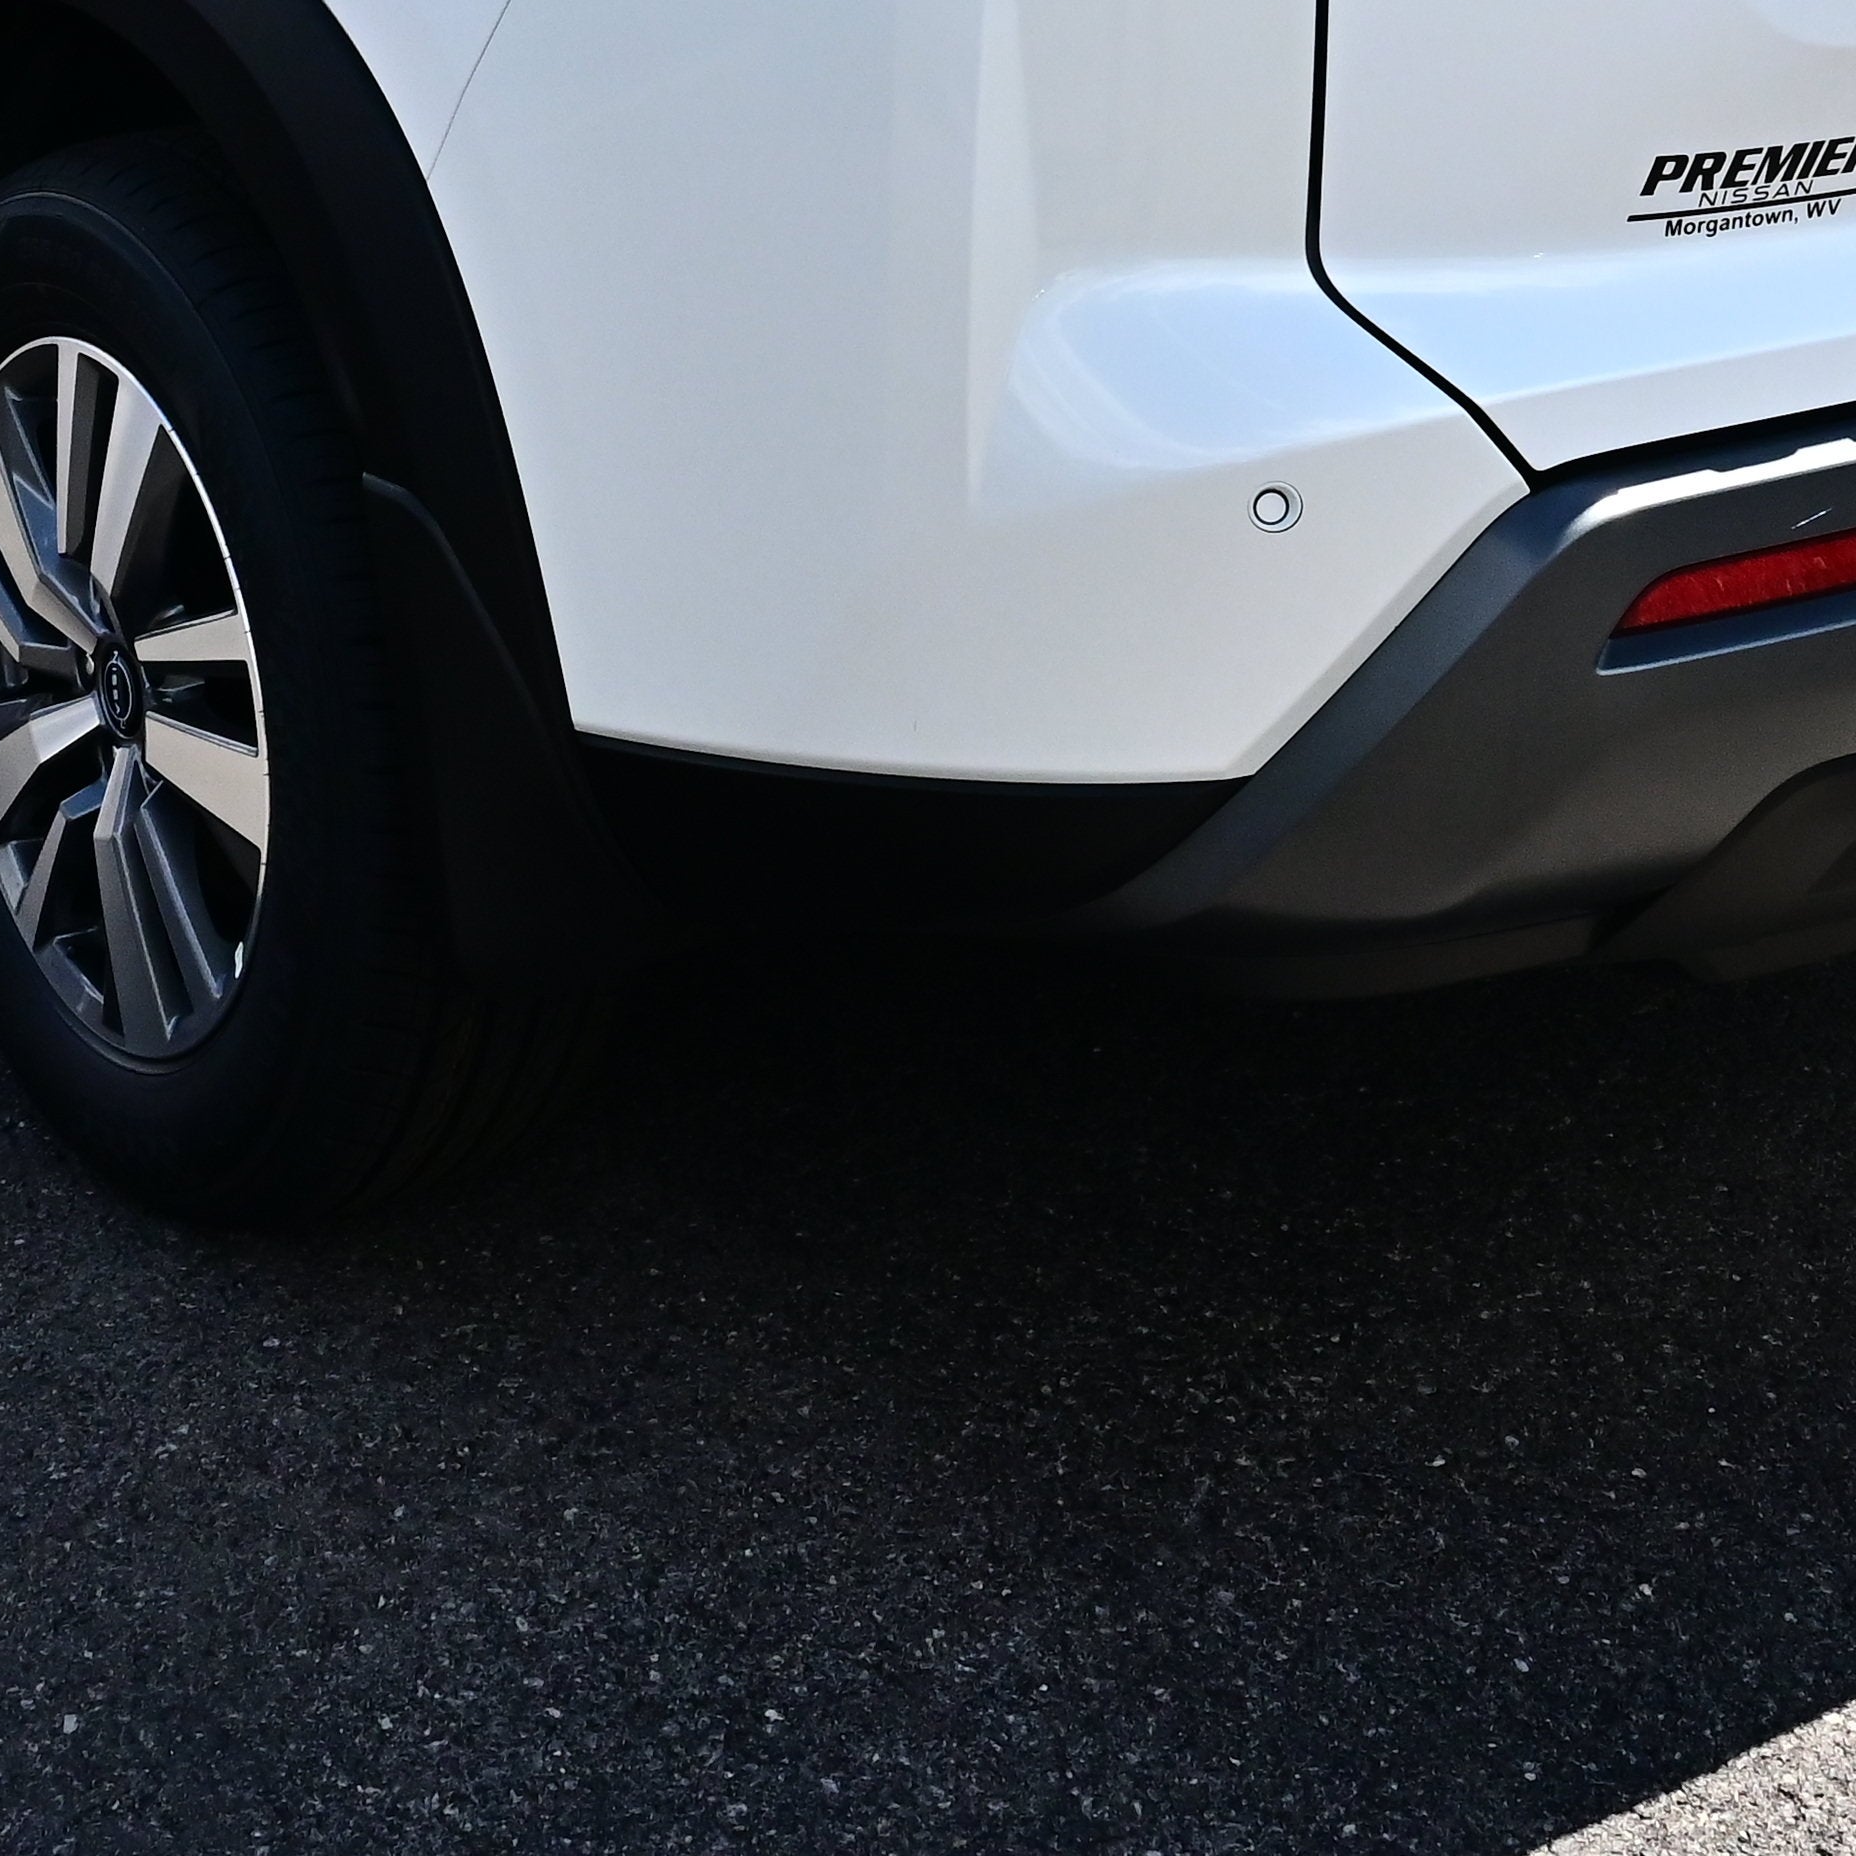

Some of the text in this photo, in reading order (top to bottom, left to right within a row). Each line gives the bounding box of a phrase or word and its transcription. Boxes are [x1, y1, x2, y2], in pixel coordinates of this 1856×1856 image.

[1698, 180, 1814, 207] NISSAN
[1664, 198, 1842, 237] Morgantown, WV
